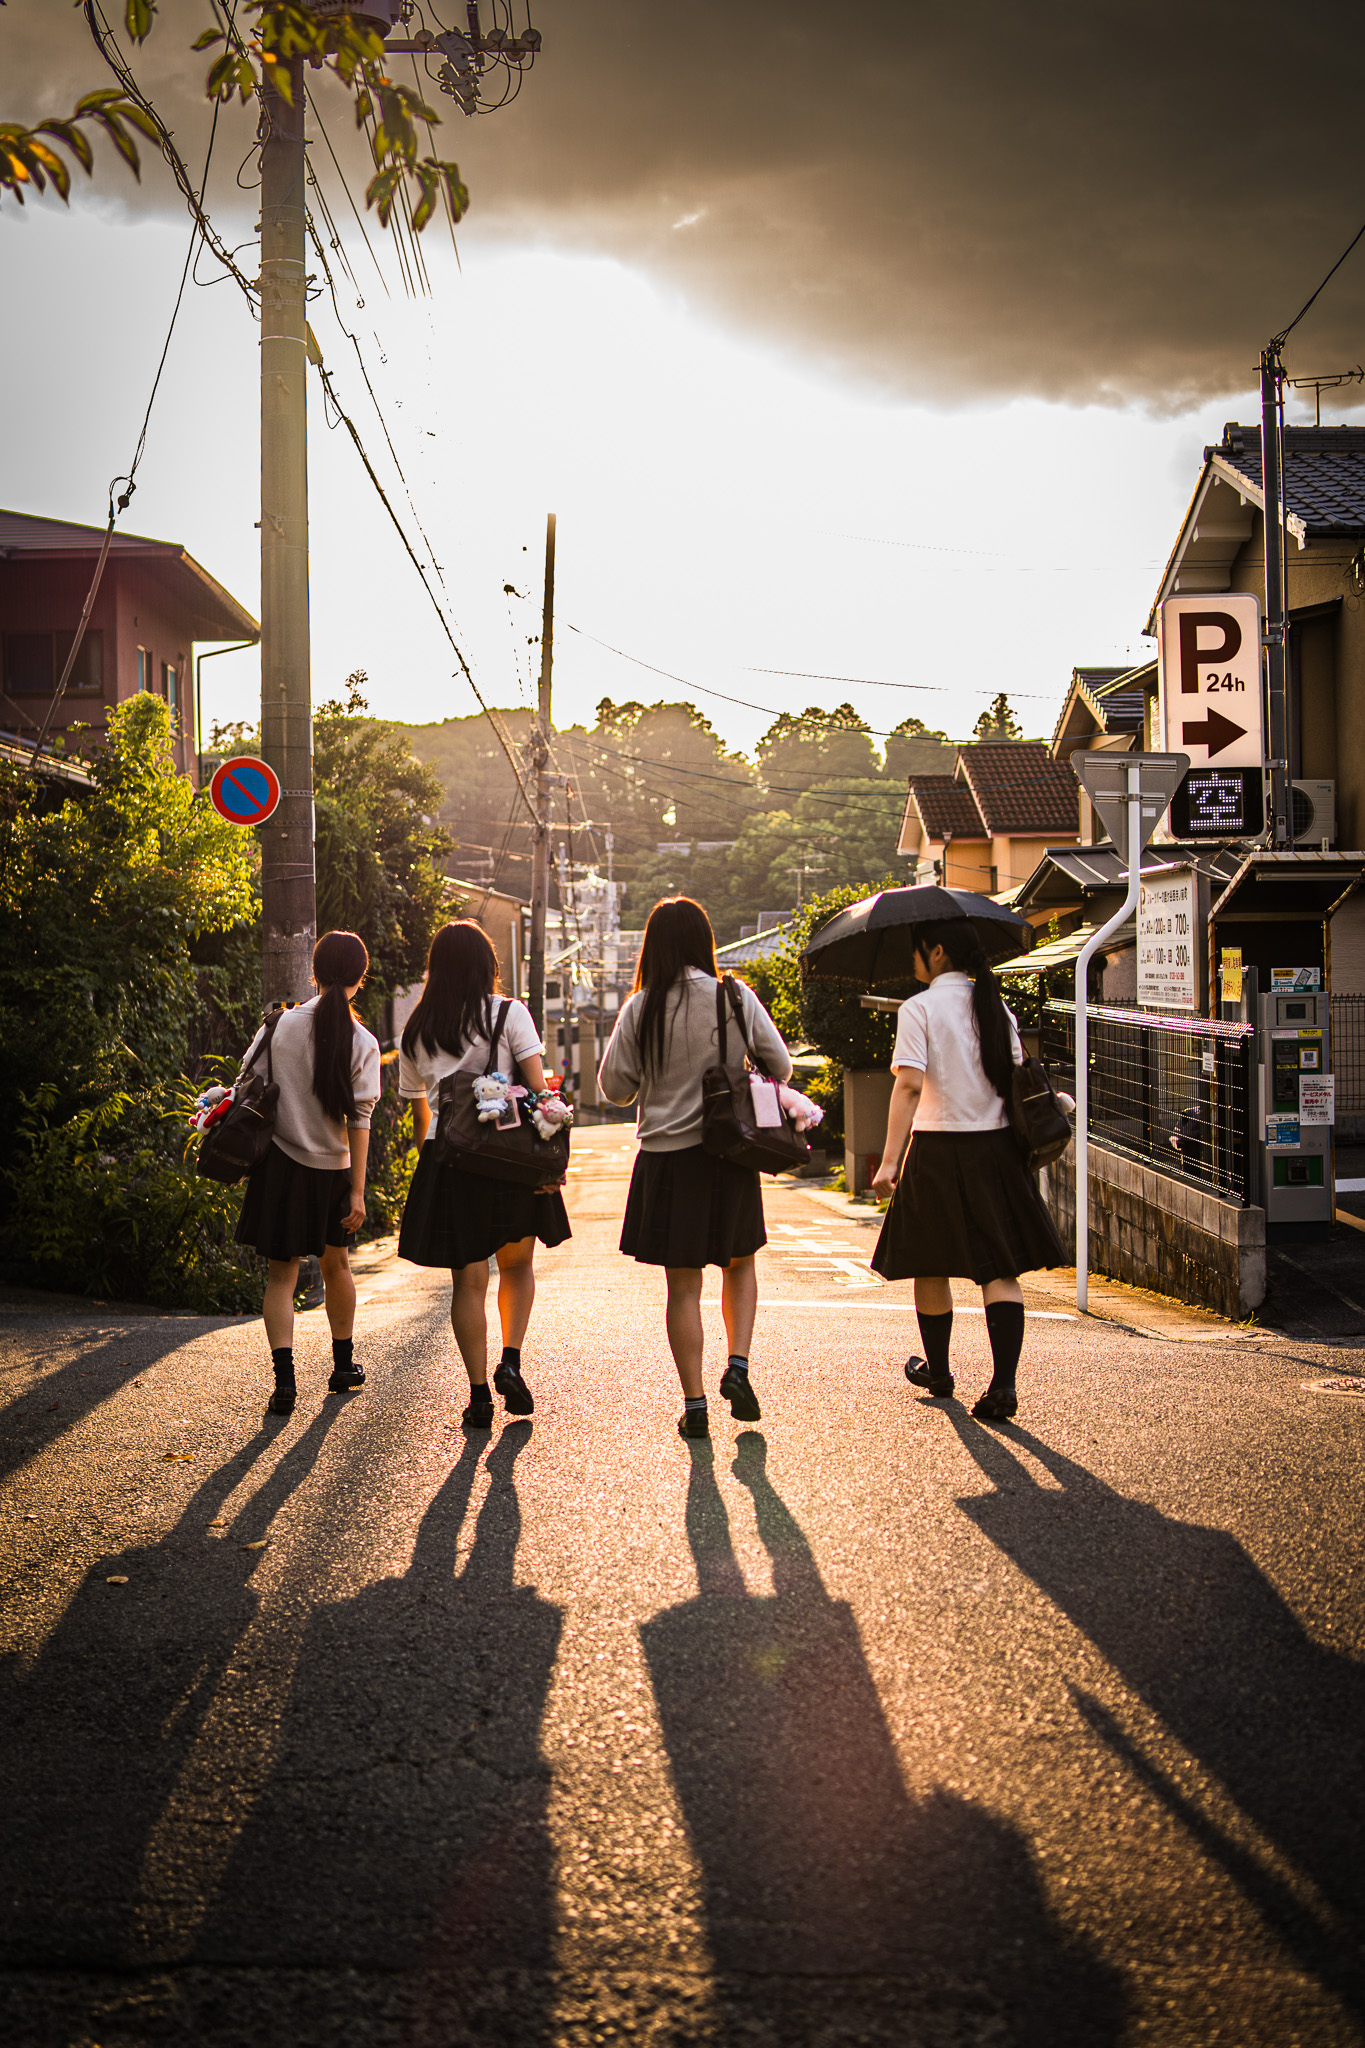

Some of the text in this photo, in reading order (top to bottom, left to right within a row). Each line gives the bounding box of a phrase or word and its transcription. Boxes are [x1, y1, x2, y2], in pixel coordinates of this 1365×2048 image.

[1179, 611, 1242, 694] P
[1206, 672, 1246, 693] 24h
[1187, 771, 1243, 828] 空
